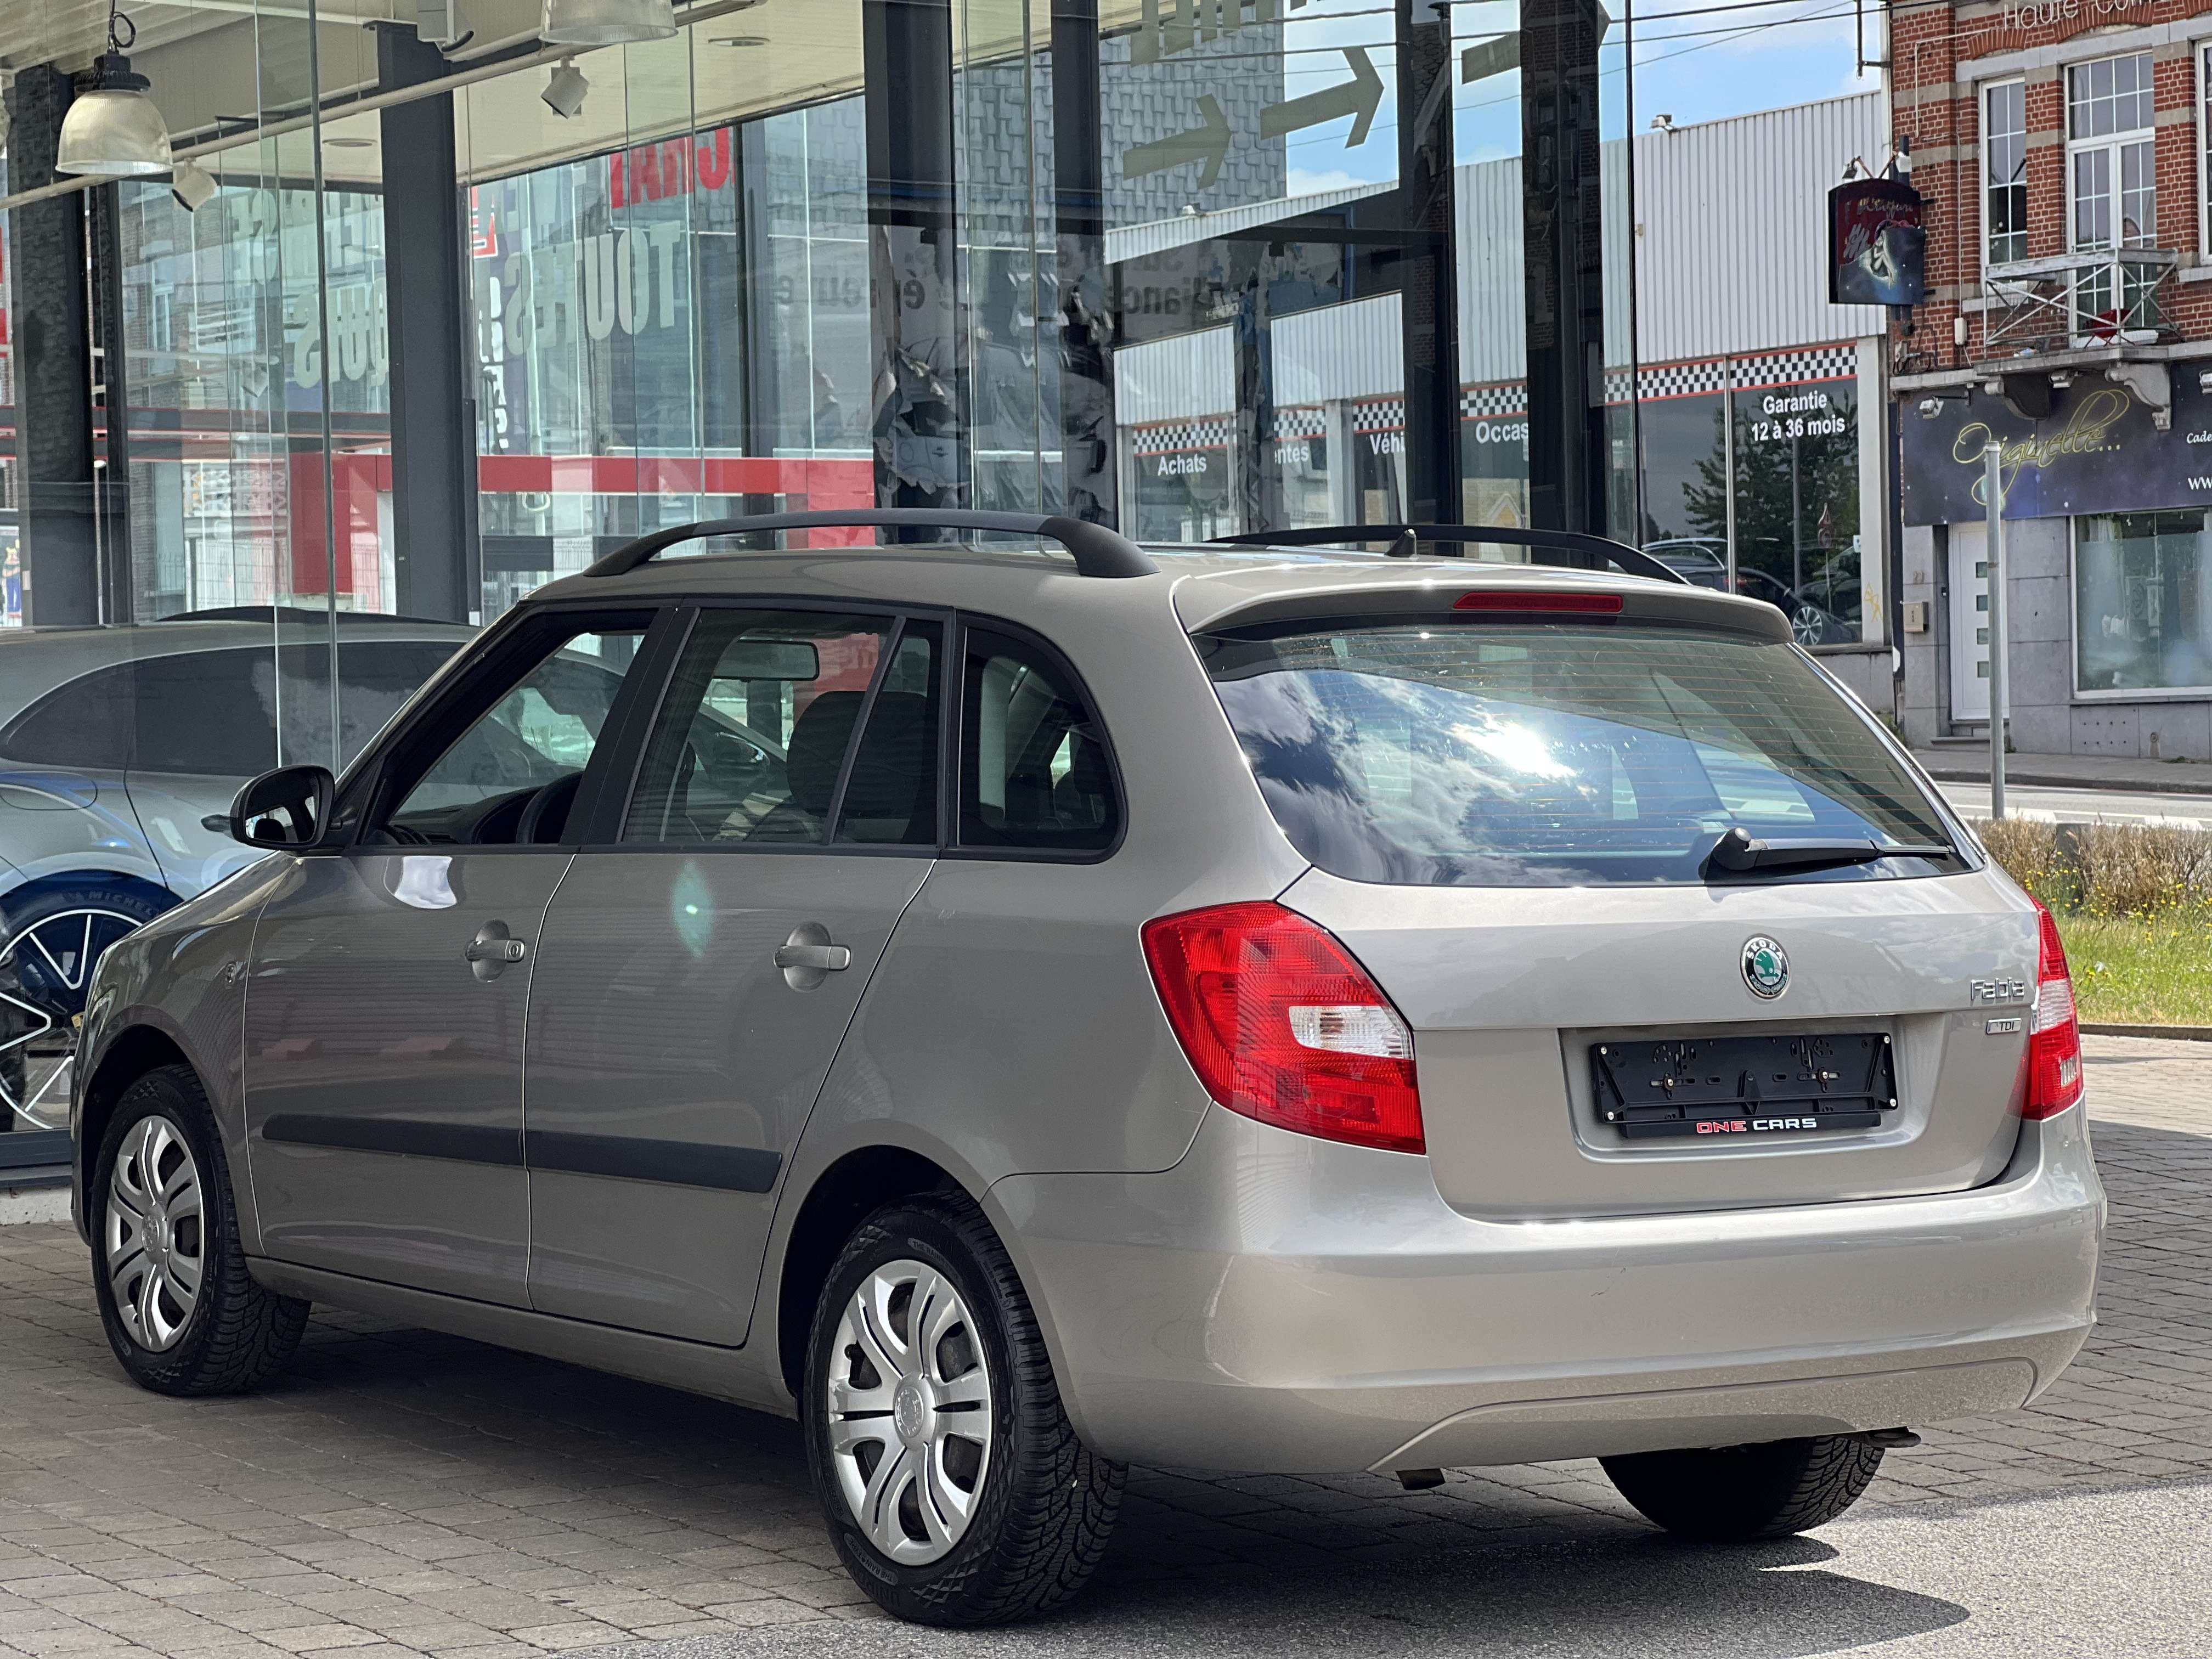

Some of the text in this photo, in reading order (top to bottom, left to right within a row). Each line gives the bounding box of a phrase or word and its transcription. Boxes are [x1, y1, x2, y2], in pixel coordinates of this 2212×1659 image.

[1763, 390, 1827, 415] Garantie
[1475, 421, 1528, 444] Occas
[1751, 414, 1846, 442] 12 à 36 mois
[1369, 431, 1405, 455] Véhi
[1158, 453, 1207, 476] Achats
[1970, 977, 2024, 1001] Fabia
[2000, 1021, 2015, 1031] TDI
[1696, 1118, 1817, 1133] ONE CARS
